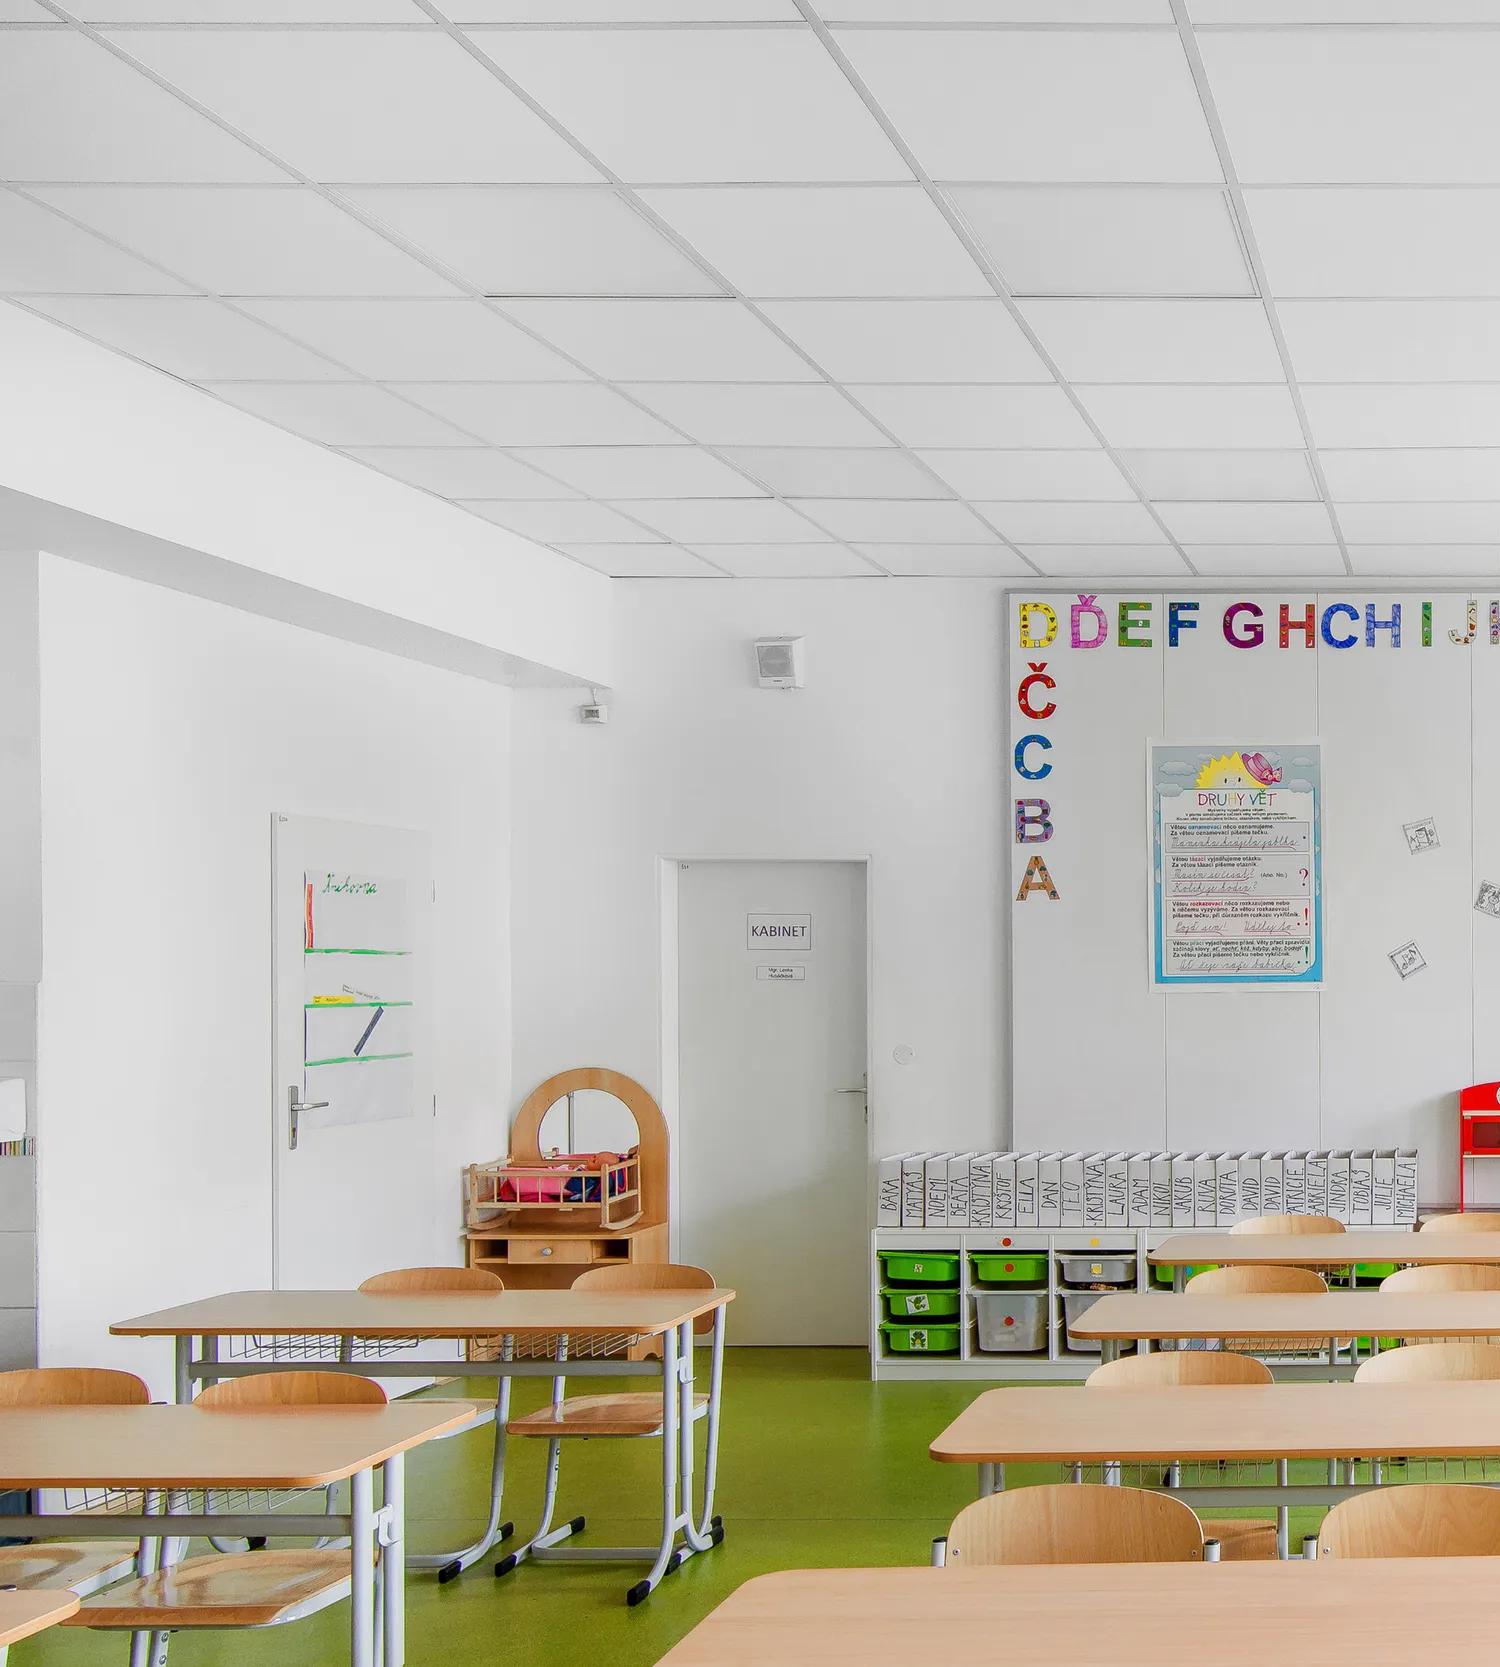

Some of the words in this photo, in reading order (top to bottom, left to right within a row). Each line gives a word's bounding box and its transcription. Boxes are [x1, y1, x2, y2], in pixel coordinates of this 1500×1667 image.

[1019, 602, 1059, 647] D
[1071, 595, 1107, 649] Ď
[1118, 603, 1152, 647] E
[1169, 602, 1199, 647] F
[1222, 603, 1264, 649] G
[1279, 603, 1315, 648] H
[1422, 602, 1432, 647] I
[1448, 600, 1476, 646] J
[1018, 662, 1057, 720] Č
[1015, 734, 1052, 780] C
[1198, 793, 1245, 806] DRUHY
[1250, 788, 1277, 806] VĚT
[1015, 798, 1053, 843] B
[1016, 856, 1060, 900] A
[752, 926, 807, 937] KABINET
[880, 1178, 899, 1211] BÁRA
[902, 1171, 923, 1219] MATYÁŠ
[928, 1178, 947, 1218] NOEMI
[993, 1172, 1012, 1220] KRYŠTOF
[1042, 1181, 1058, 1209] DAN
[1061, 1181, 1081, 1216] TEO
[1108, 1172, 1127, 1216] LAURA
[1131, 1178, 1149, 1215] ADAM
[1153, 1178, 1170, 1216] NIKOL
[1174, 1176, 1193, 1214] JAKUB
[1219, 1170, 1237, 1215] DOROTA
[1241, 1177, 1259, 1211] DAVID
[1263, 1176, 1281, 1211] DAVID
[1329, 1170, 1348, 1212] JINDRA
[1351, 1169, 1370, 1214] TOBIÁŠ
[1374, 1177, 1394, 1210] JULIE
[1396, 1162, 1416, 1219] MICHAELA
